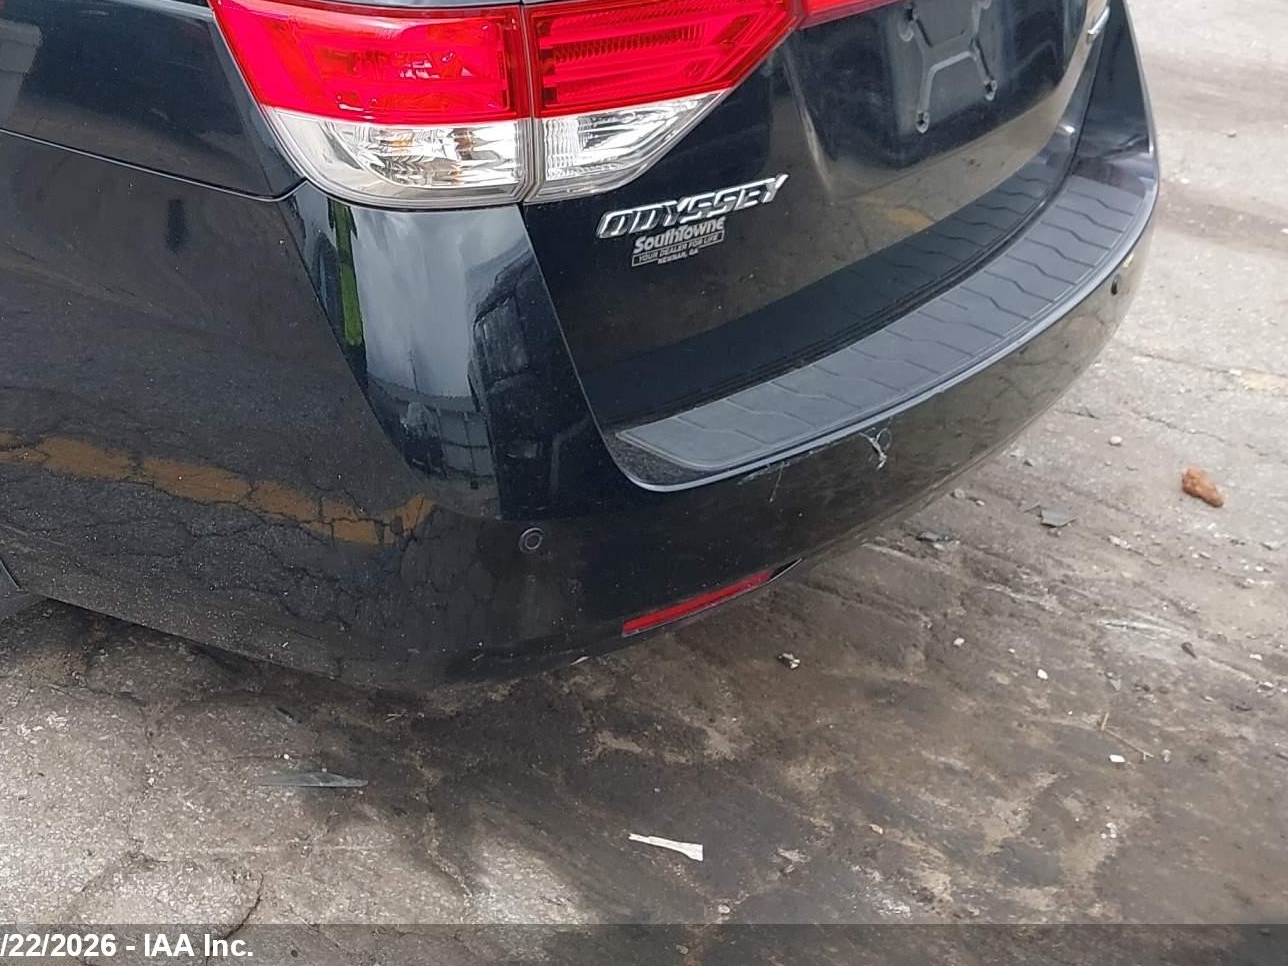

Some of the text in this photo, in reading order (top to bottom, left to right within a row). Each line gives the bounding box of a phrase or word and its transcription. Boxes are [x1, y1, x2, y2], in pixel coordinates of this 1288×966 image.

[596, 173, 789, 239] ODYSSEY
[639, 251, 658, 263] YOUR
[660, 243, 687, 257] DEALER
